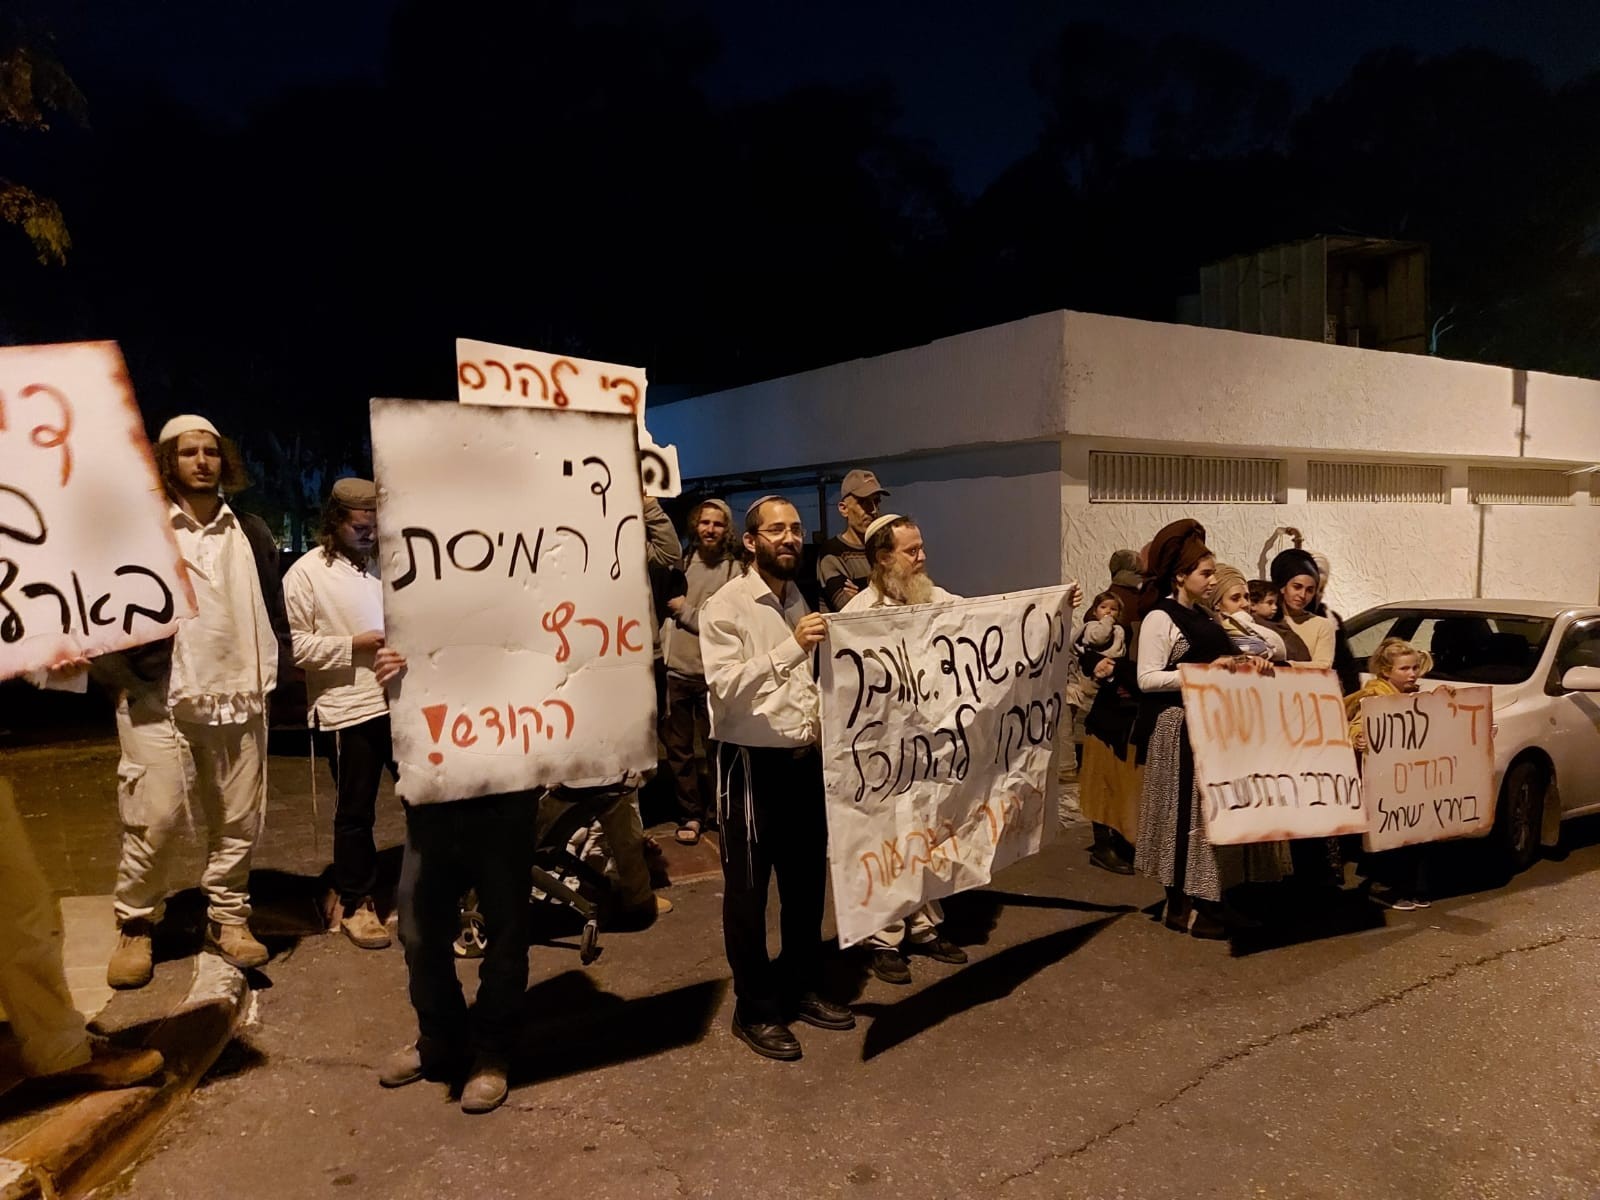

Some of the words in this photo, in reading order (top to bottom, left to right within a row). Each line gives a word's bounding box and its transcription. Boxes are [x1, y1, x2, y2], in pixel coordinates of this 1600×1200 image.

[459, 359, 579, 408] להרס
[600, 375, 640, 417] די
[562, 456, 612, 518] די
[391, 514, 638, 592] לרמיסת
[541, 601, 643, 663] ארץ
[834, 637, 930, 729] אורבך
[421, 698, 575, 766] הקודש!
[1185, 683, 1267, 752] ושקד
[1278, 690, 1353, 748] בנט
[1366, 697, 1429, 754] לגרוש
[1447, 702, 1485, 746] די
[851, 703, 977, 803] להתנכל
[1393, 755, 1457, 794] יהודים
[1378, 797, 1426, 834] ישראל
[1433, 795, 1481, 829] בארץ
